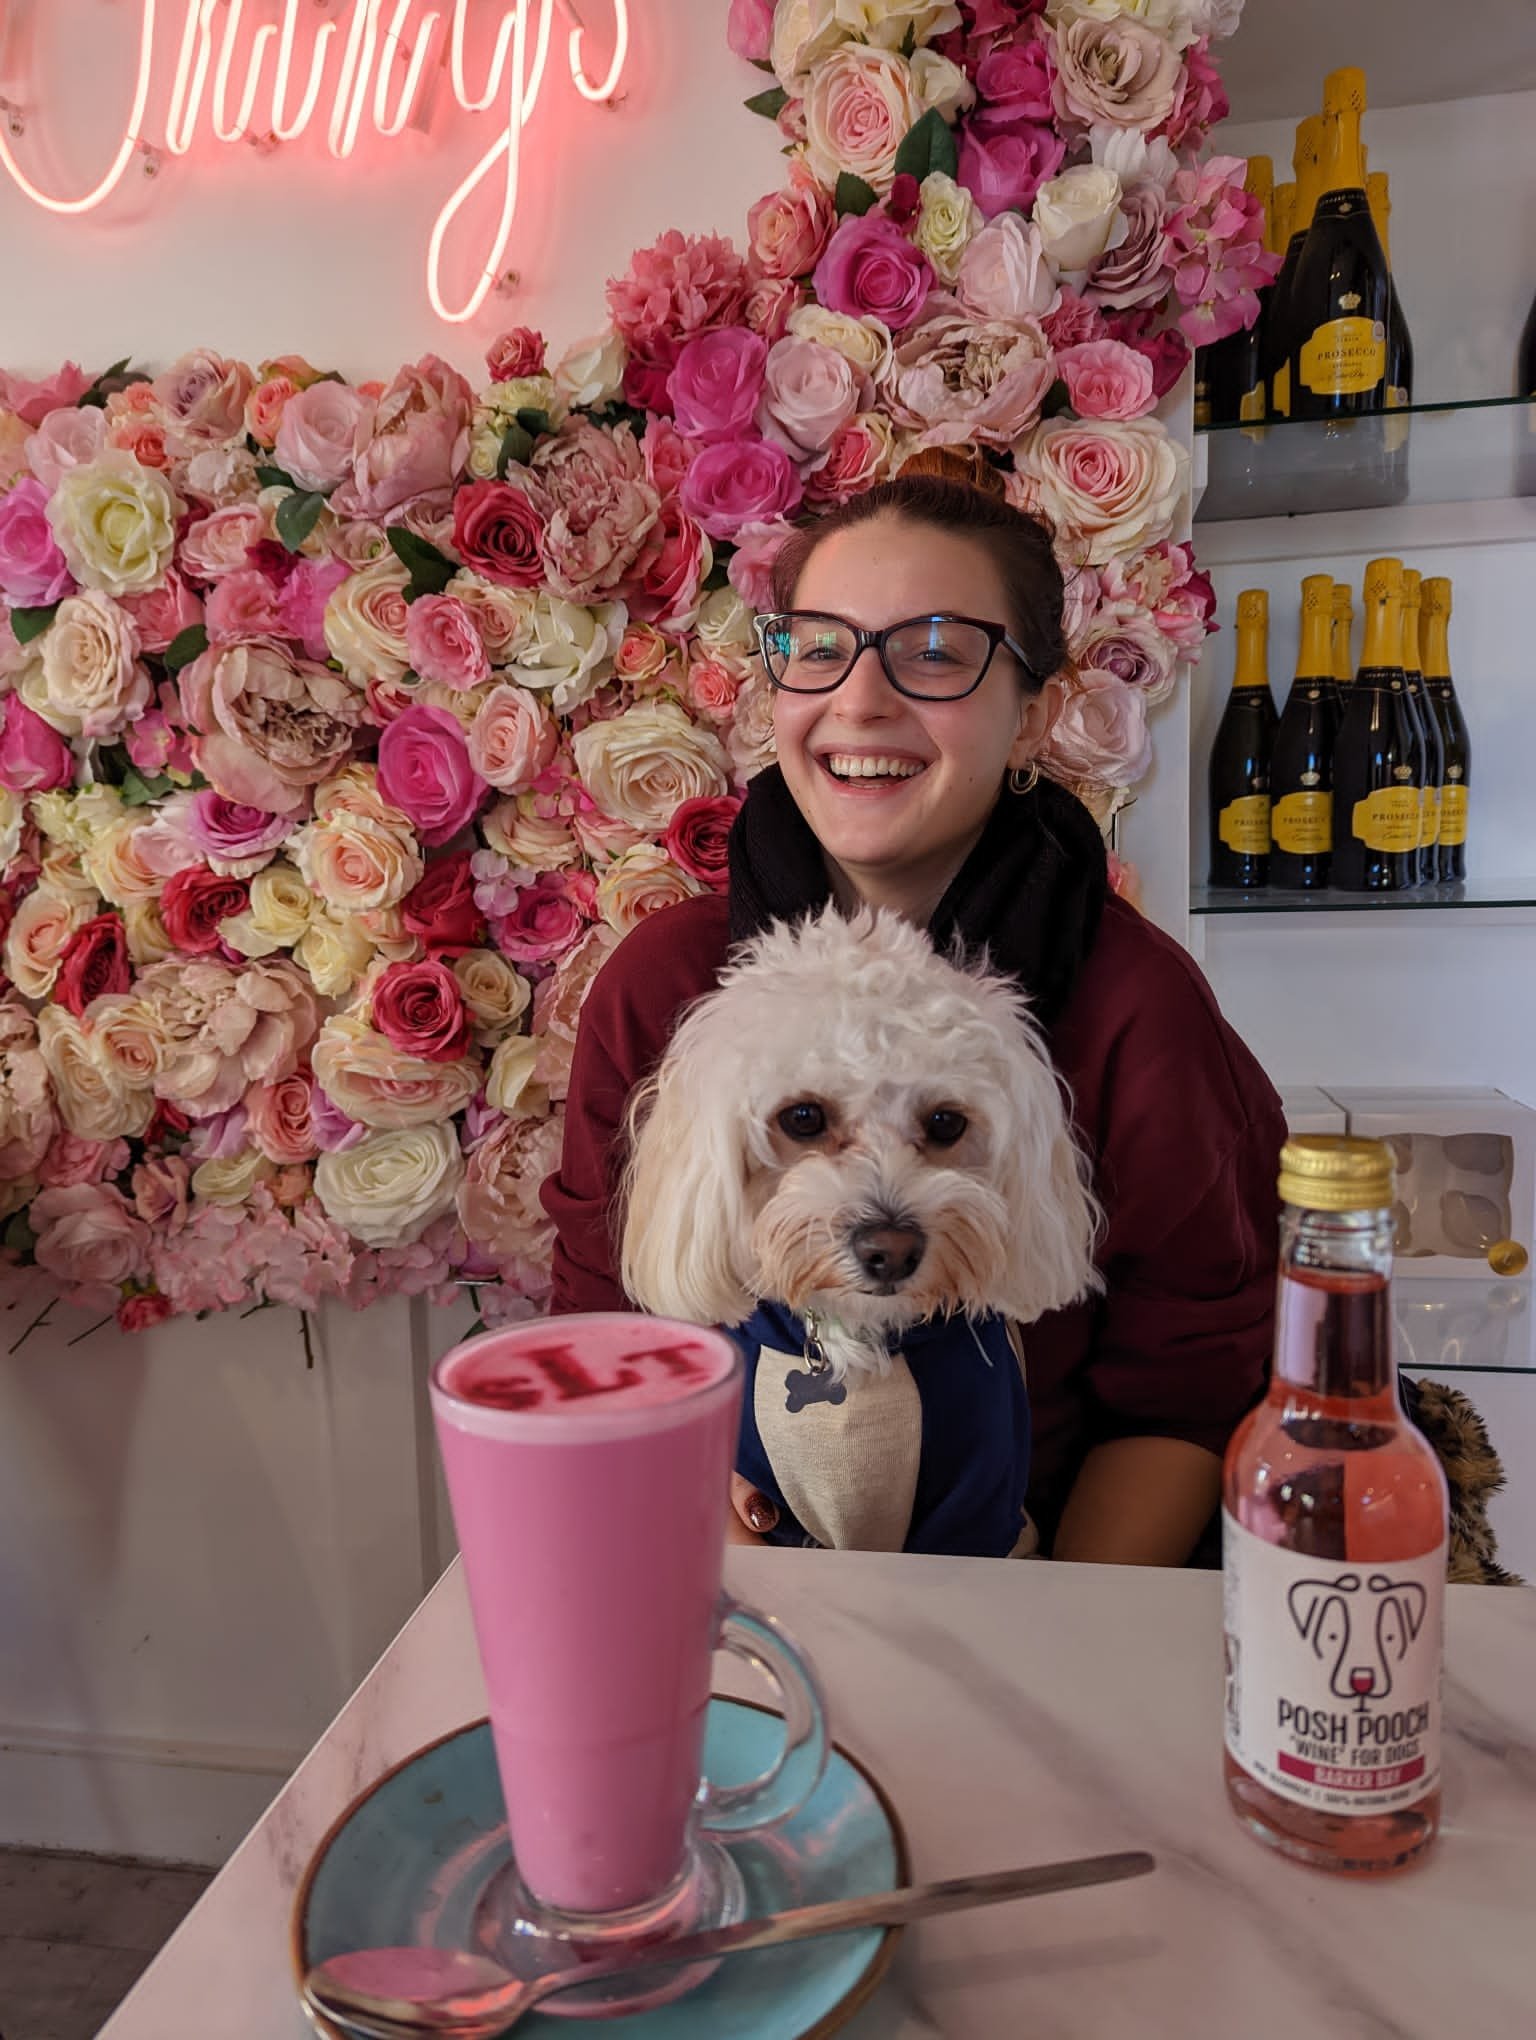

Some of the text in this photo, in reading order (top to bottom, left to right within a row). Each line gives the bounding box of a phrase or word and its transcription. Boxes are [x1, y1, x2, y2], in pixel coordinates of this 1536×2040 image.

[1317, 347, 1376, 361] PROSECCO
[1278, 1697, 1429, 1745] POSH POOCH
[1351, 1747, 1383, 1766] FOR
